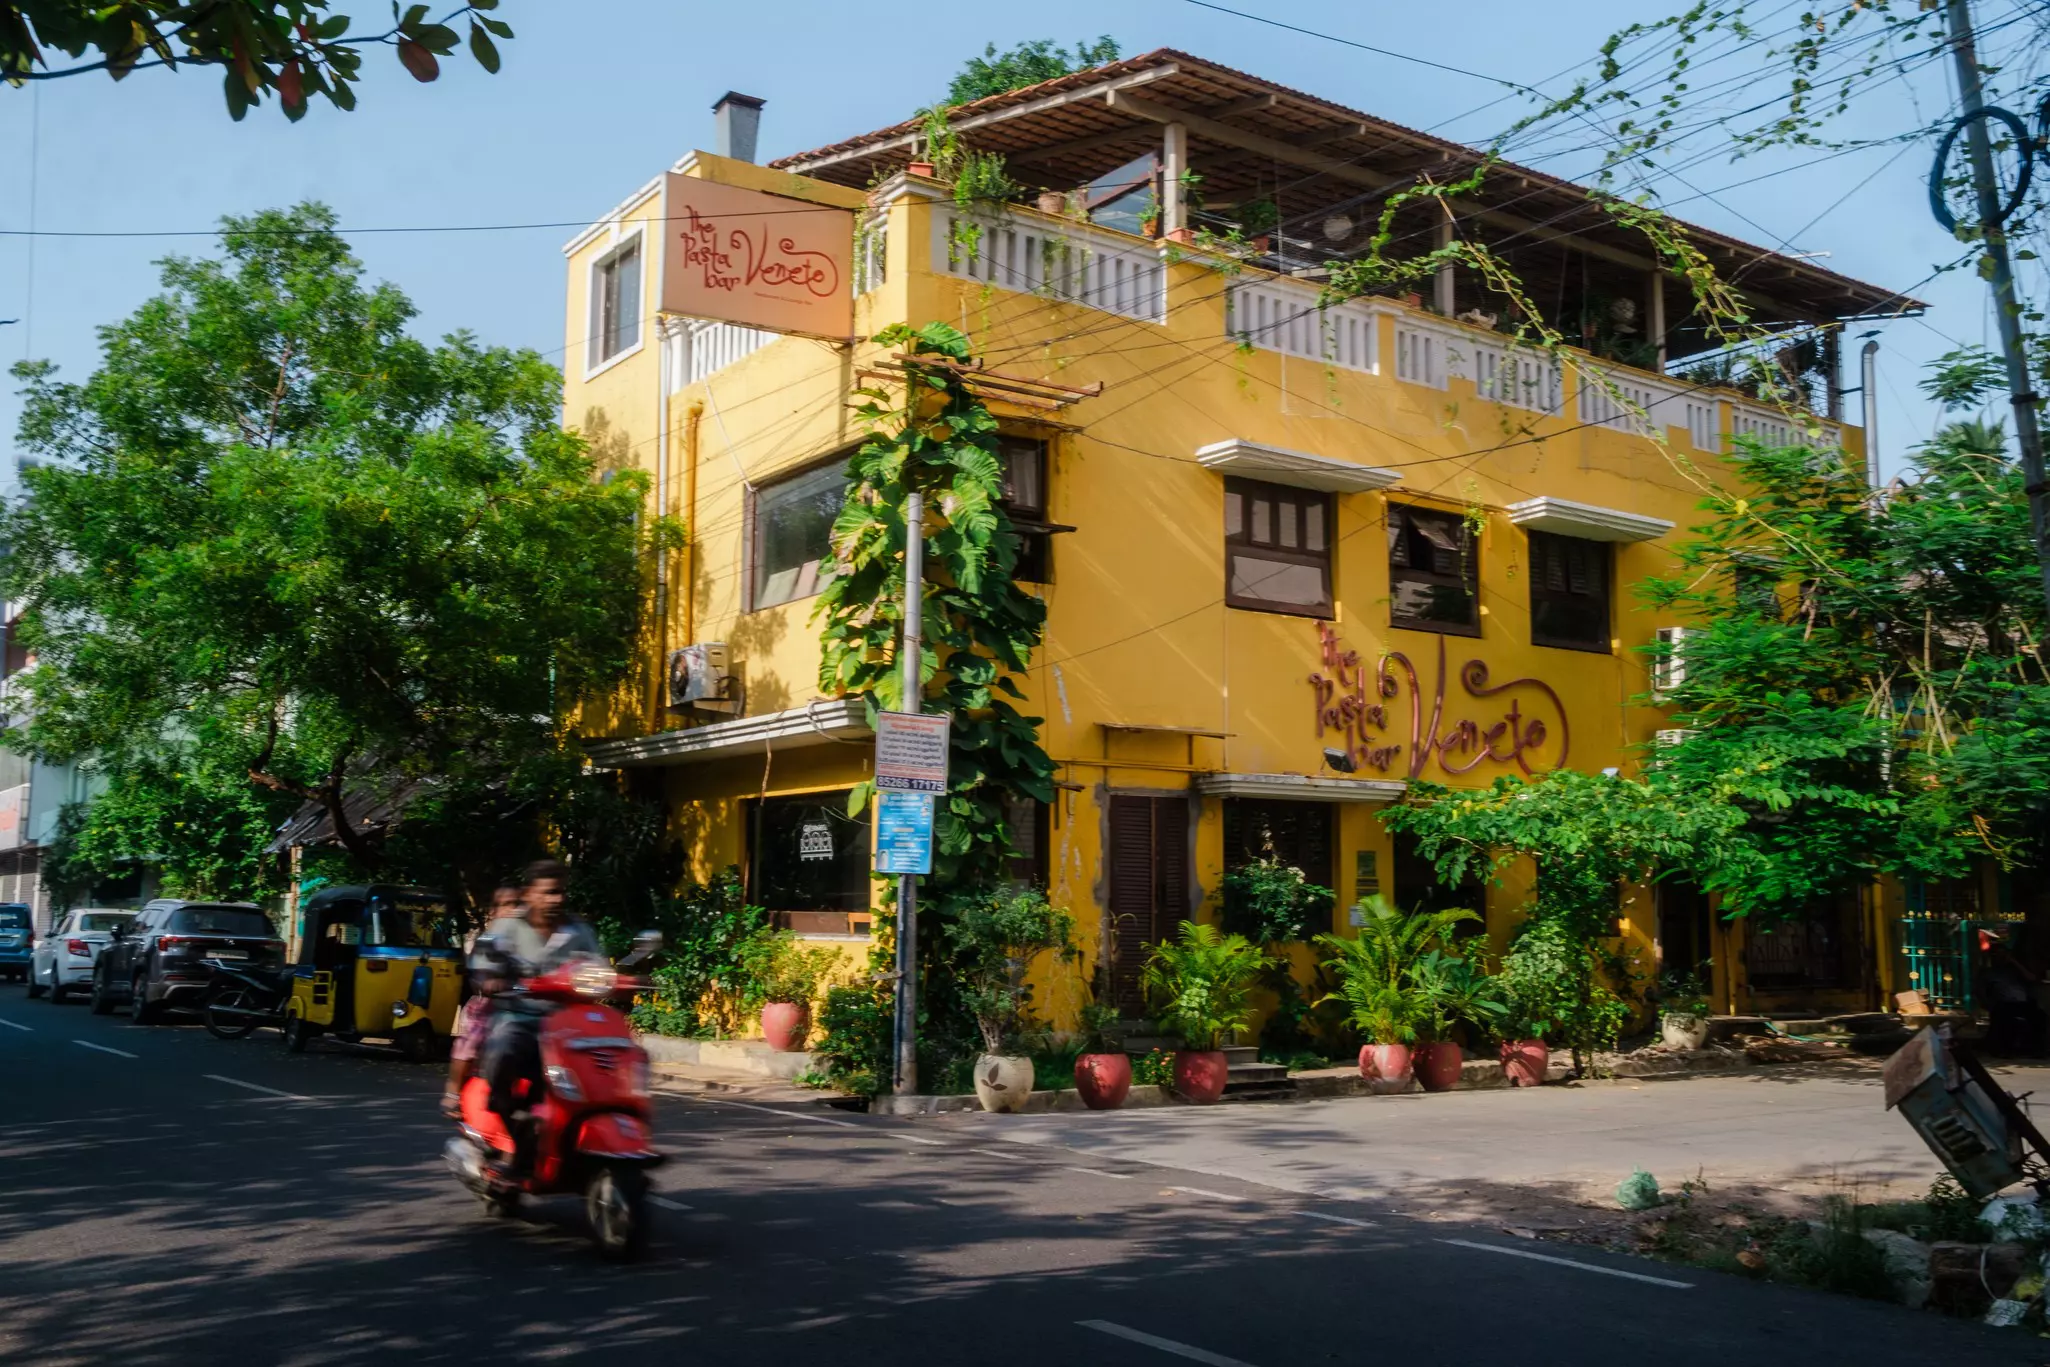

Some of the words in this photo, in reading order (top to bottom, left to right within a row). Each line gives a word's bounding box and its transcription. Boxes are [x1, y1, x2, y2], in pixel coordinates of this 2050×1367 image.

[680, 231, 733, 275] Pasta
[704, 262, 741, 292] bar
[730, 220, 839, 298] Veneto
[1377, 632, 1570, 780] Veneto
